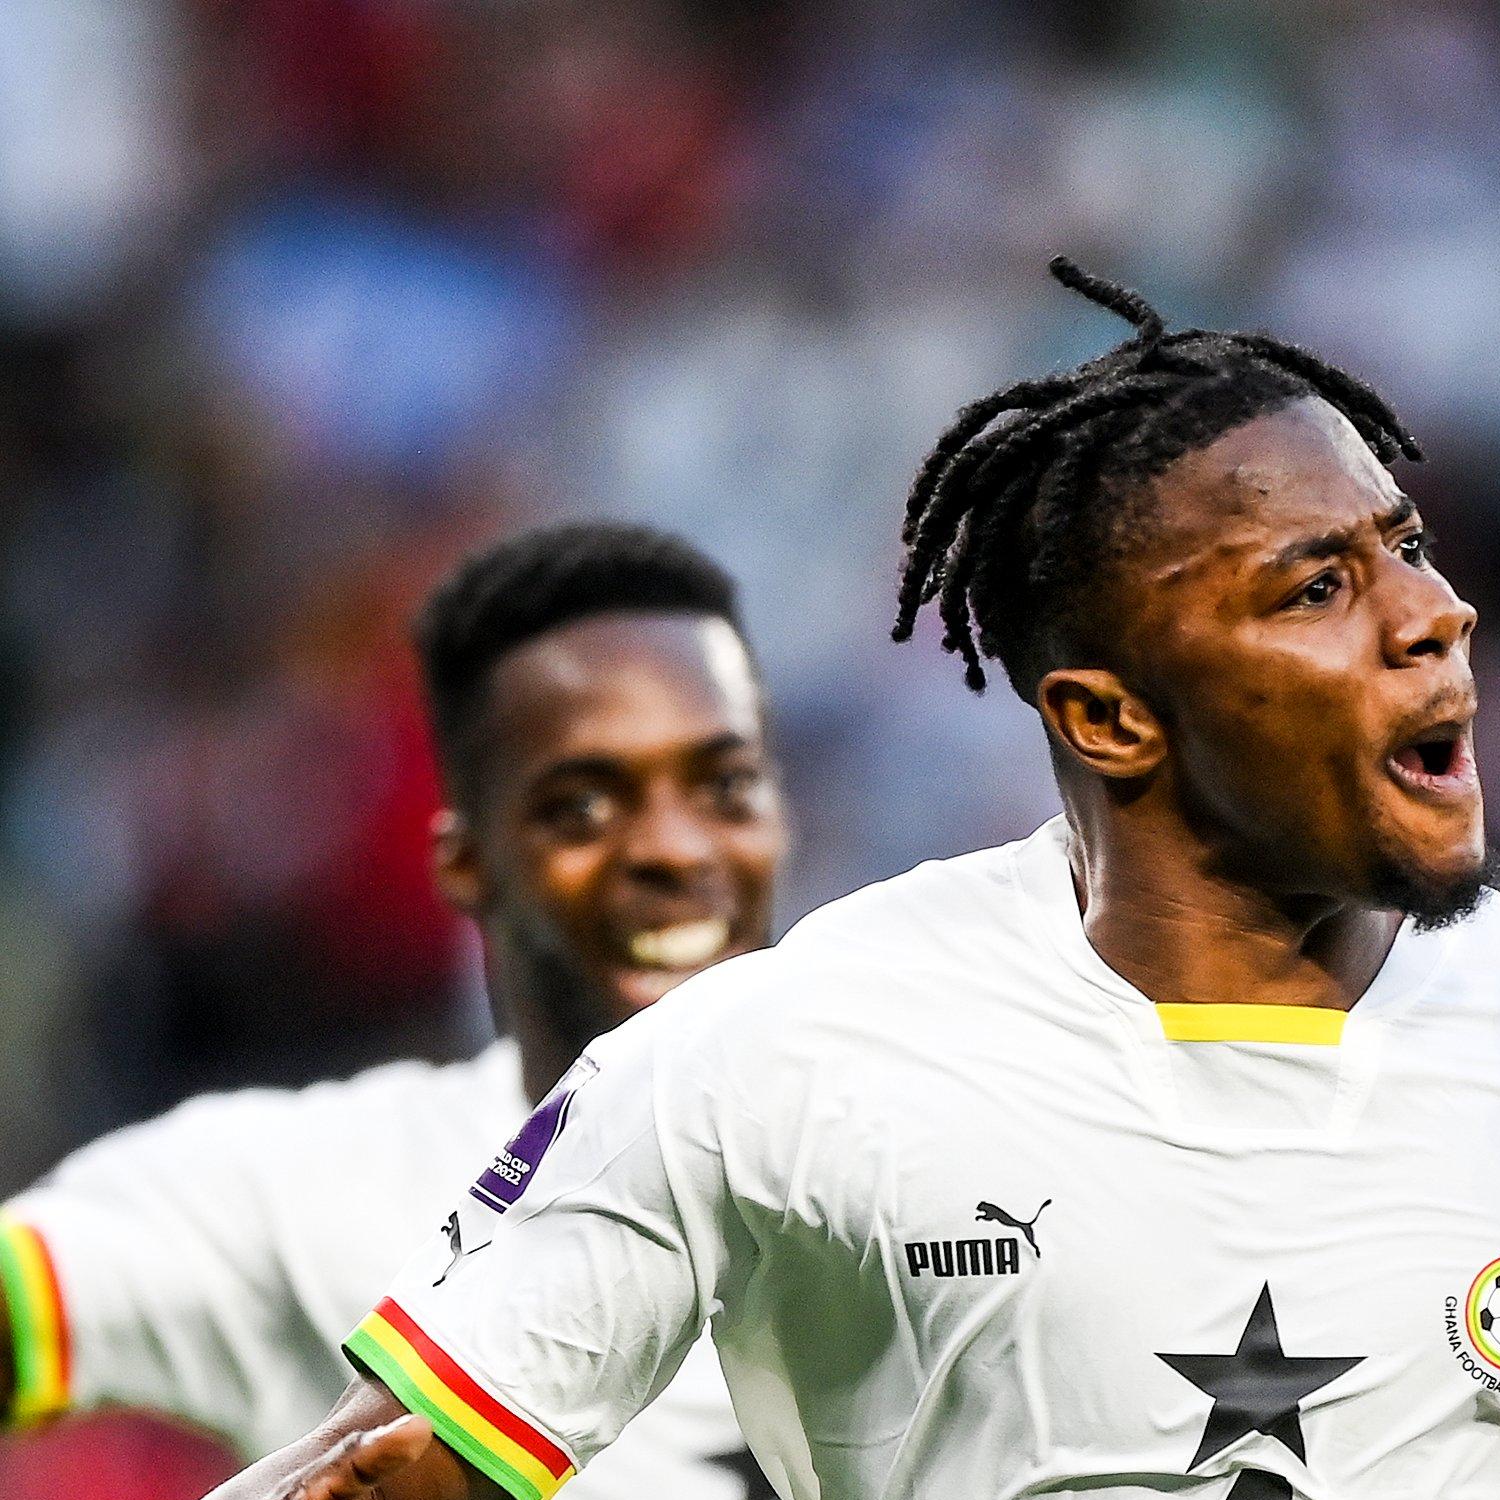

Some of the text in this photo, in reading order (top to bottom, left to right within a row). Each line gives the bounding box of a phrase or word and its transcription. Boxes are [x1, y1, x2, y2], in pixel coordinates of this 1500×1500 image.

[493, 1162, 522, 1186] 2022
[510, 1156, 531, 1174] CUP
[904, 1237, 1020, 1278] PUMA
[1444, 1295, 1463, 1353] GHANA
